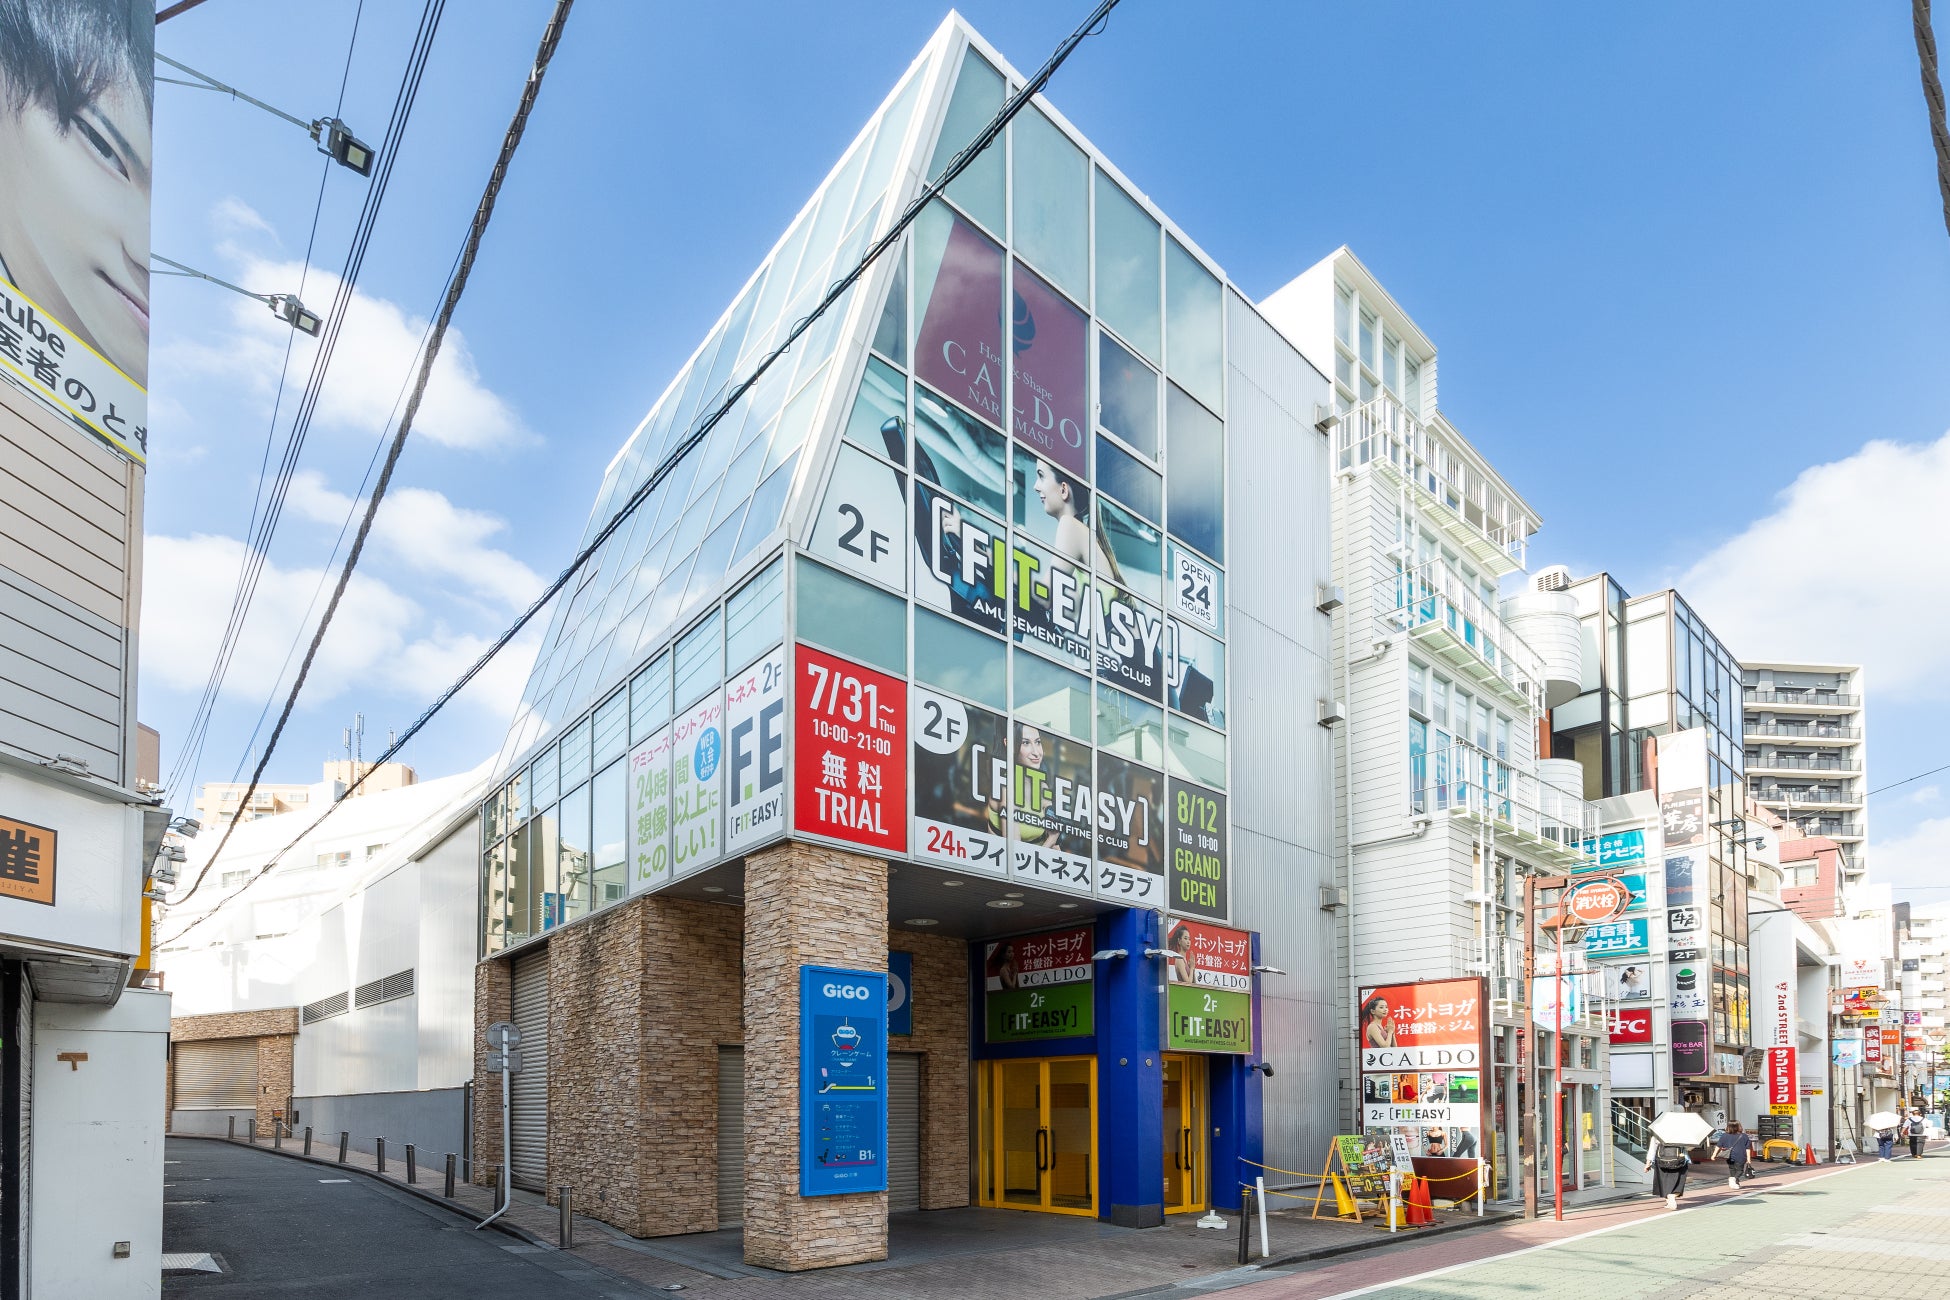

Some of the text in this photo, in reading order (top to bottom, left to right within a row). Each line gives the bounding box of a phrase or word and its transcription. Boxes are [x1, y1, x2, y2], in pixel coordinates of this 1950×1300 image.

[979, 341, 1002, 367] Hot
[1023, 371, 1053, 401] Shape
[967, 385, 1055, 450] NARMASU
[837, 503, 890, 563] 2F
[1181, 559, 1211, 585] OPEN
[1181, 573, 1211, 611] 24
[1181, 599, 1211, 621] HOURS
[762, 661, 782, 694] 2F
[1121, 664, 1152, 687] CLUB
[878, 717, 896, 735] Thu
[923, 700, 961, 744] 2F
[700, 731, 715, 750] WEB
[700, 748, 715, 766] 入会
[814, 787, 889, 836] TRIAL
[1177, 790, 1218, 834] 8/12
[1065, 825, 1104, 843] FITNES
[1105, 836, 1129, 850] CLUB
[1177, 828, 1219, 852] Tue 10:00
[1175, 847, 1221, 881] GRAND
[1180, 877, 1217, 908] OPEN
[1575, 893, 1616, 911] 消火栓
[1022, 932, 1087, 957] ホットヨガ
[1194, 933, 1248, 957] ホットヨガ
[1674, 950, 1697, 960] 2F
[1030, 966, 1086, 985] CALDO
[1203, 972, 1247, 989] CALDO
[822, 983, 870, 1001] GiGO
[1030, 992, 1045, 1008] 2F
[1203, 993, 1218, 1012] 2F
[1393, 998, 1477, 1021] ホットヨガ
[1777, 994, 1789, 1045] 2nd STREET
[1378, 1049, 1476, 1067] CALDO
[1775, 1048, 1789, 1103] サンドラッグ
[1371, 1109, 1385, 1120] 2F
[859, 1149, 877, 1161] B1F
